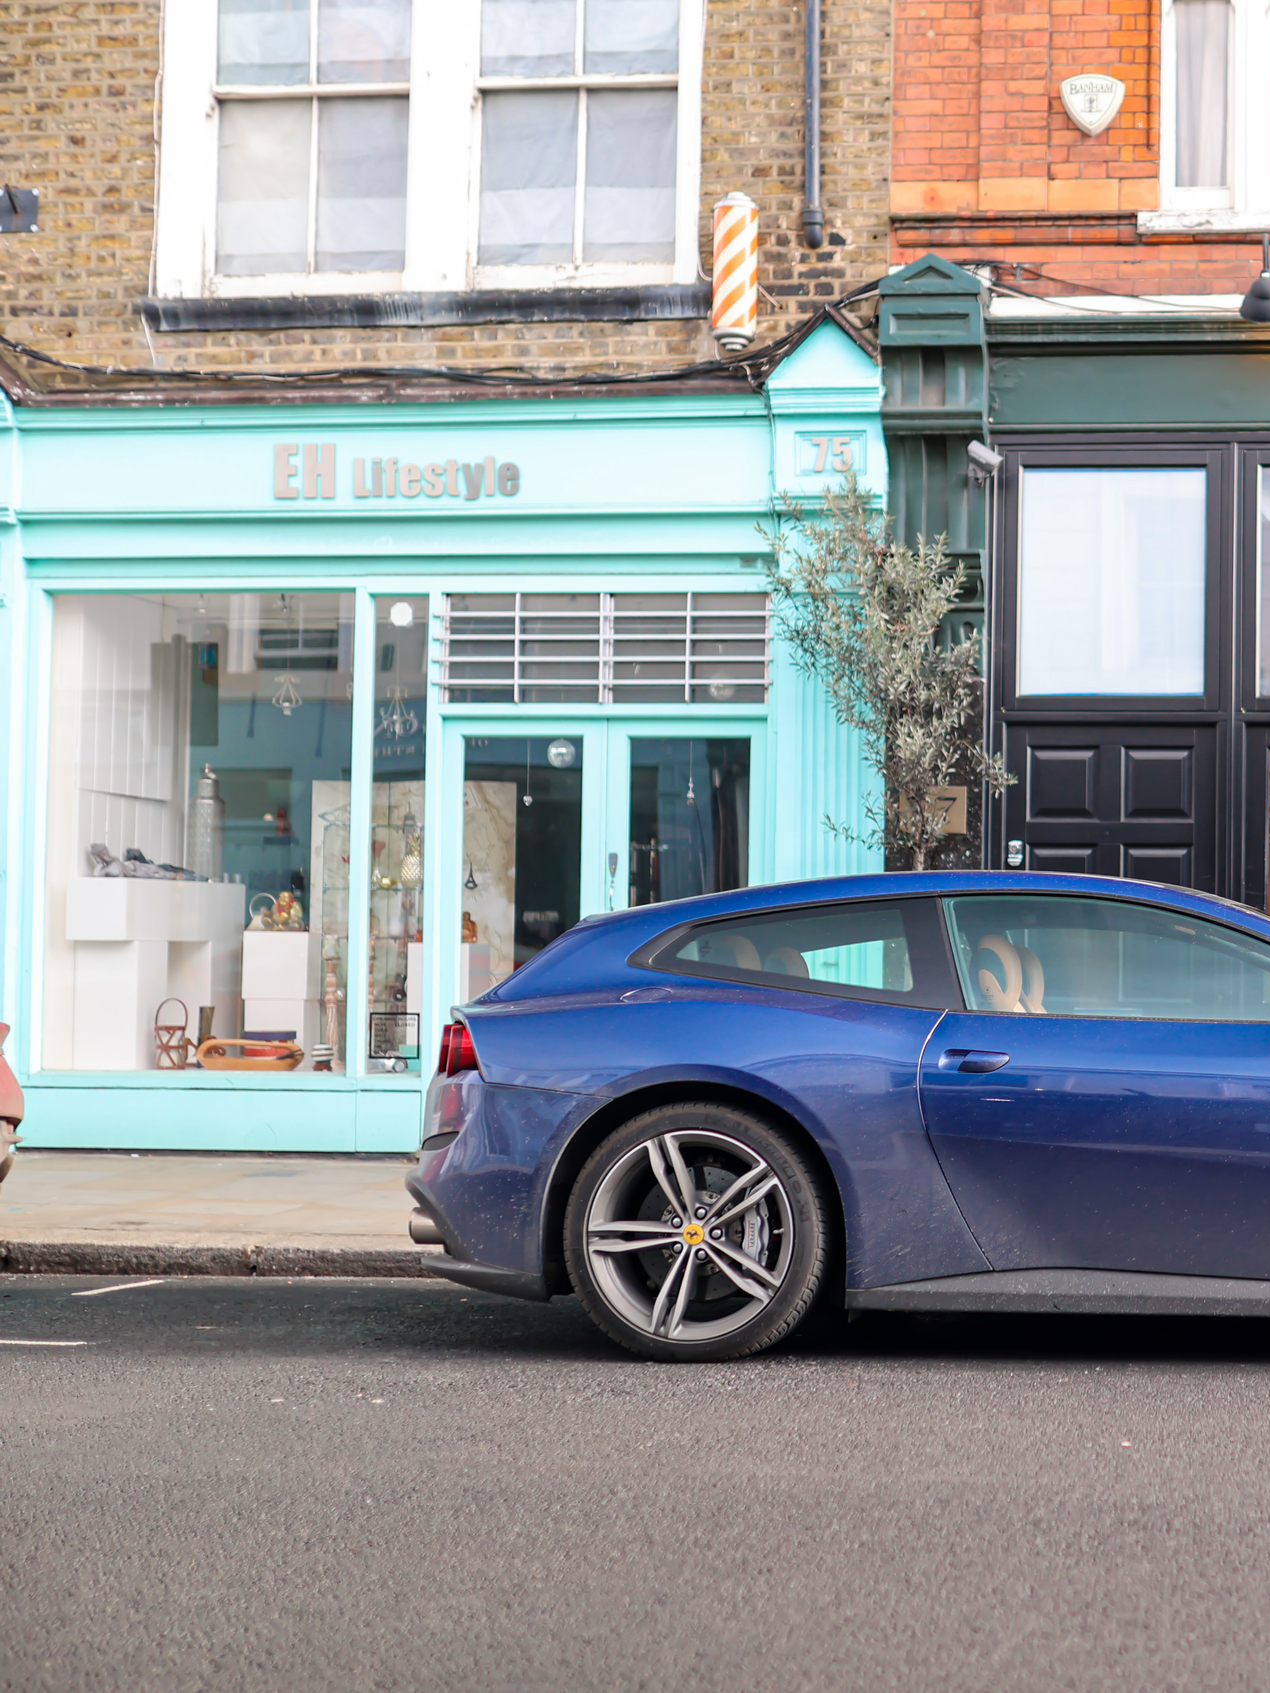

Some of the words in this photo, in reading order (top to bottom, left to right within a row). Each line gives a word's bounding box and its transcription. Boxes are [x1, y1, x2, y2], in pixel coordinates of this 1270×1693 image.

[1069, 83, 1113, 95] BANHAM
[274, 443, 336, 499] EH
[354, 456, 520, 501] Lifestyle
[812, 437, 853, 472] 75
